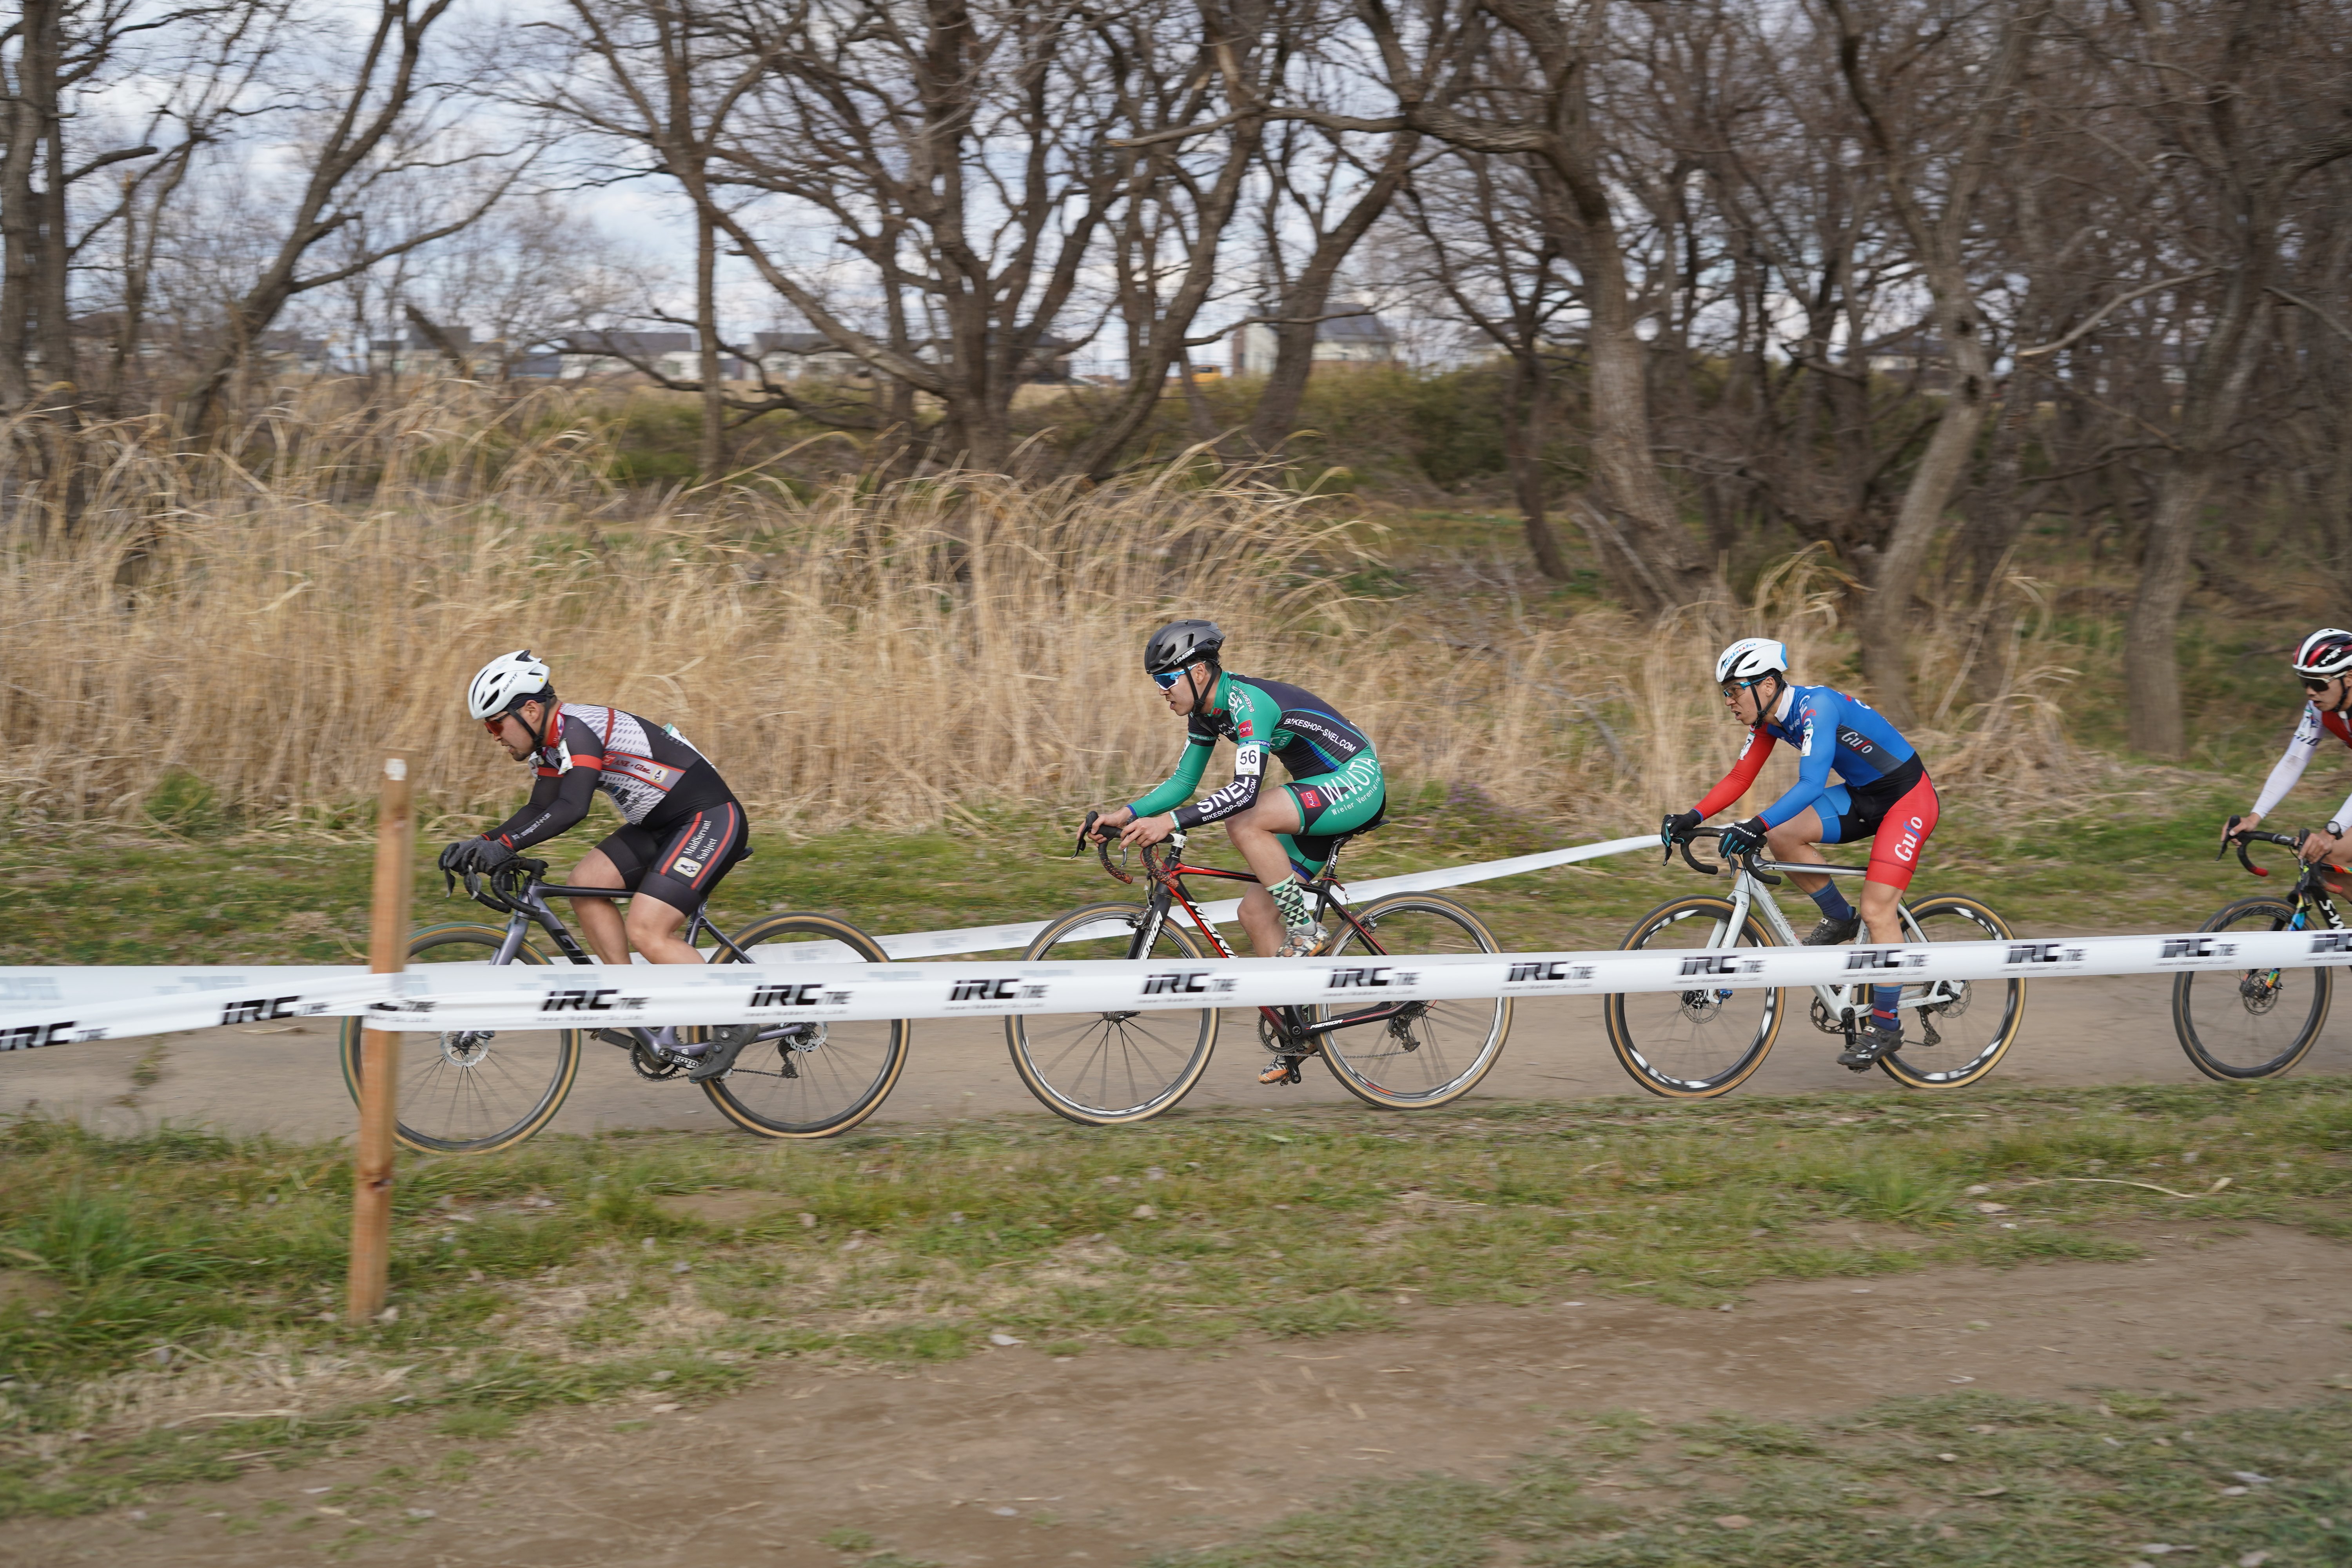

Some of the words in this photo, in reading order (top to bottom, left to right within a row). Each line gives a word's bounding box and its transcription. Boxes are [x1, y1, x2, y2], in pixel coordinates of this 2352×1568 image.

[1724, 643, 1756, 668] Kabuto
[1284, 718, 1356, 753] BIKESHOP-SNEL.COM
[1841, 731, 1873, 753] Gufo
[1240, 750, 1256, 765] 56
[1198, 777, 1250, 813] SNEL
[1202, 779, 1257, 822] BIKESHOP-SNEL.COM
[1332, 802, 1354, 815] Wieler
[1356, 775, 1381, 804] Vereniging
[682, 820, 712, 856] MaidServant
[696, 838, 718, 861] Subject
[1895, 817, 1922, 862] Gufo
[1140, 910, 1163, 960] ERIDA
[1310, 1019, 1343, 1029] MERIDA
